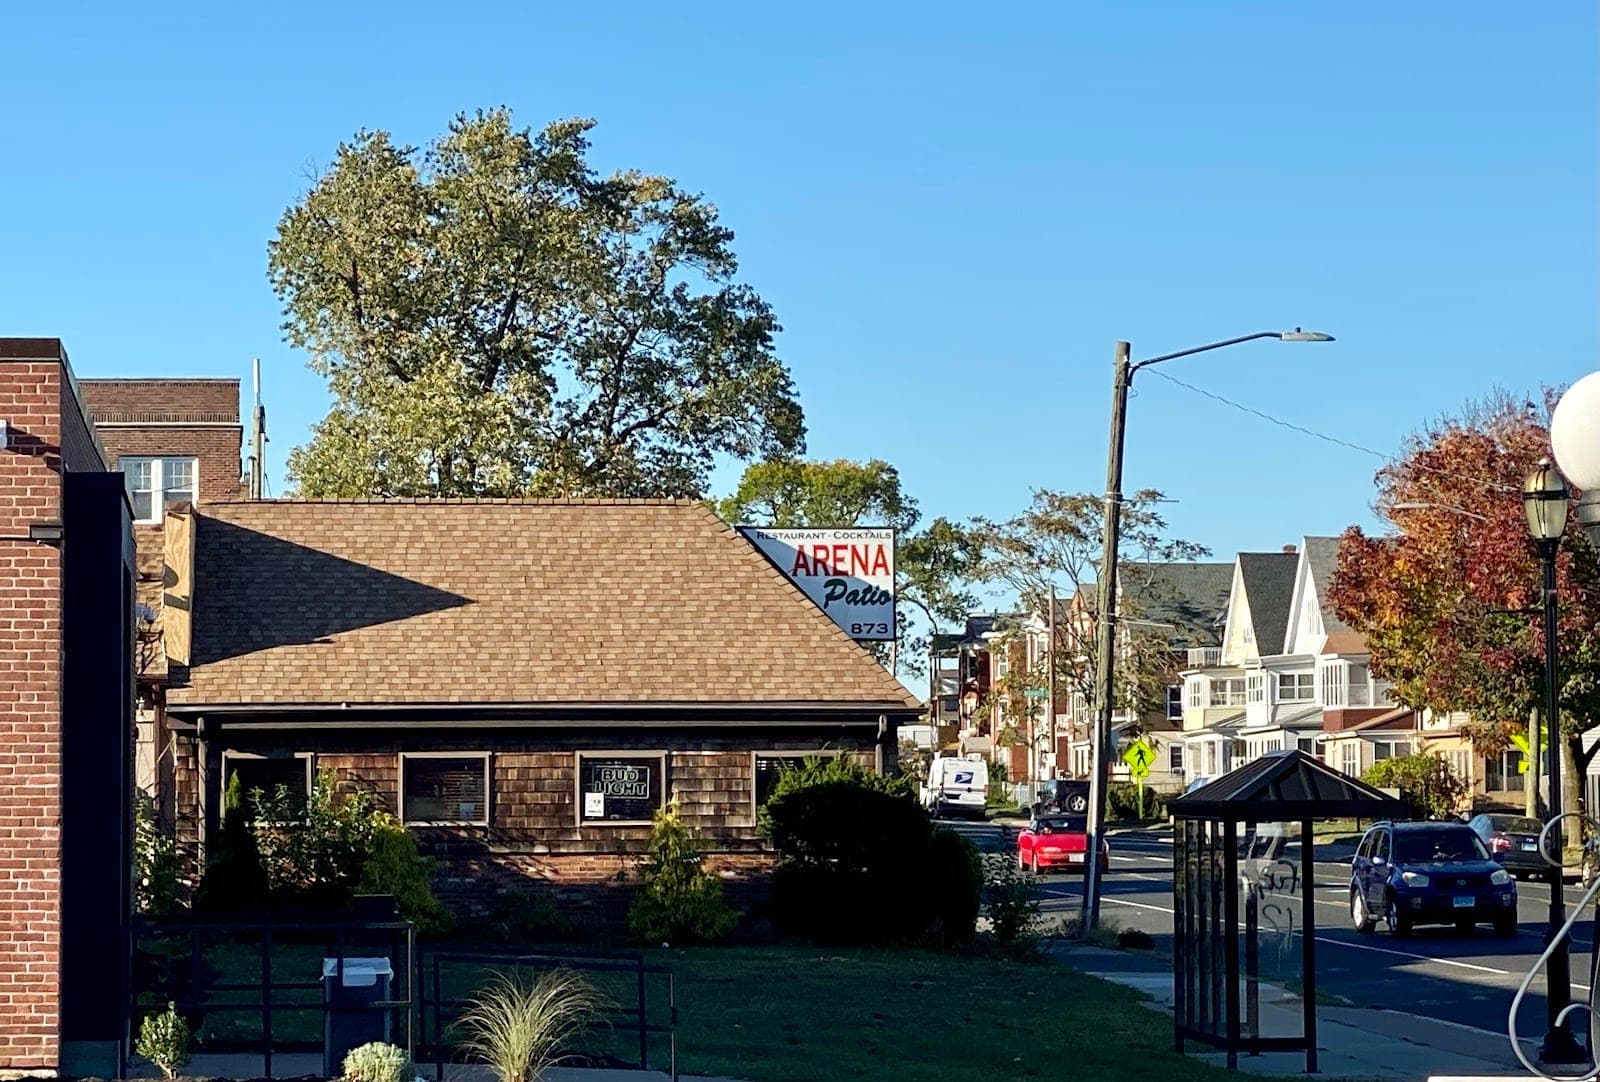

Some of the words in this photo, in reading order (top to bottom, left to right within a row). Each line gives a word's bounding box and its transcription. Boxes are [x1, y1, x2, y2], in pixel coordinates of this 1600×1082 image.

[792, 544, 890, 577] ARENA
[823, 578, 892, 609] Patio
[850, 623, 889, 634] 873
[602, 768, 639, 782] BUD
[594, 780, 646, 795] LIGHT
